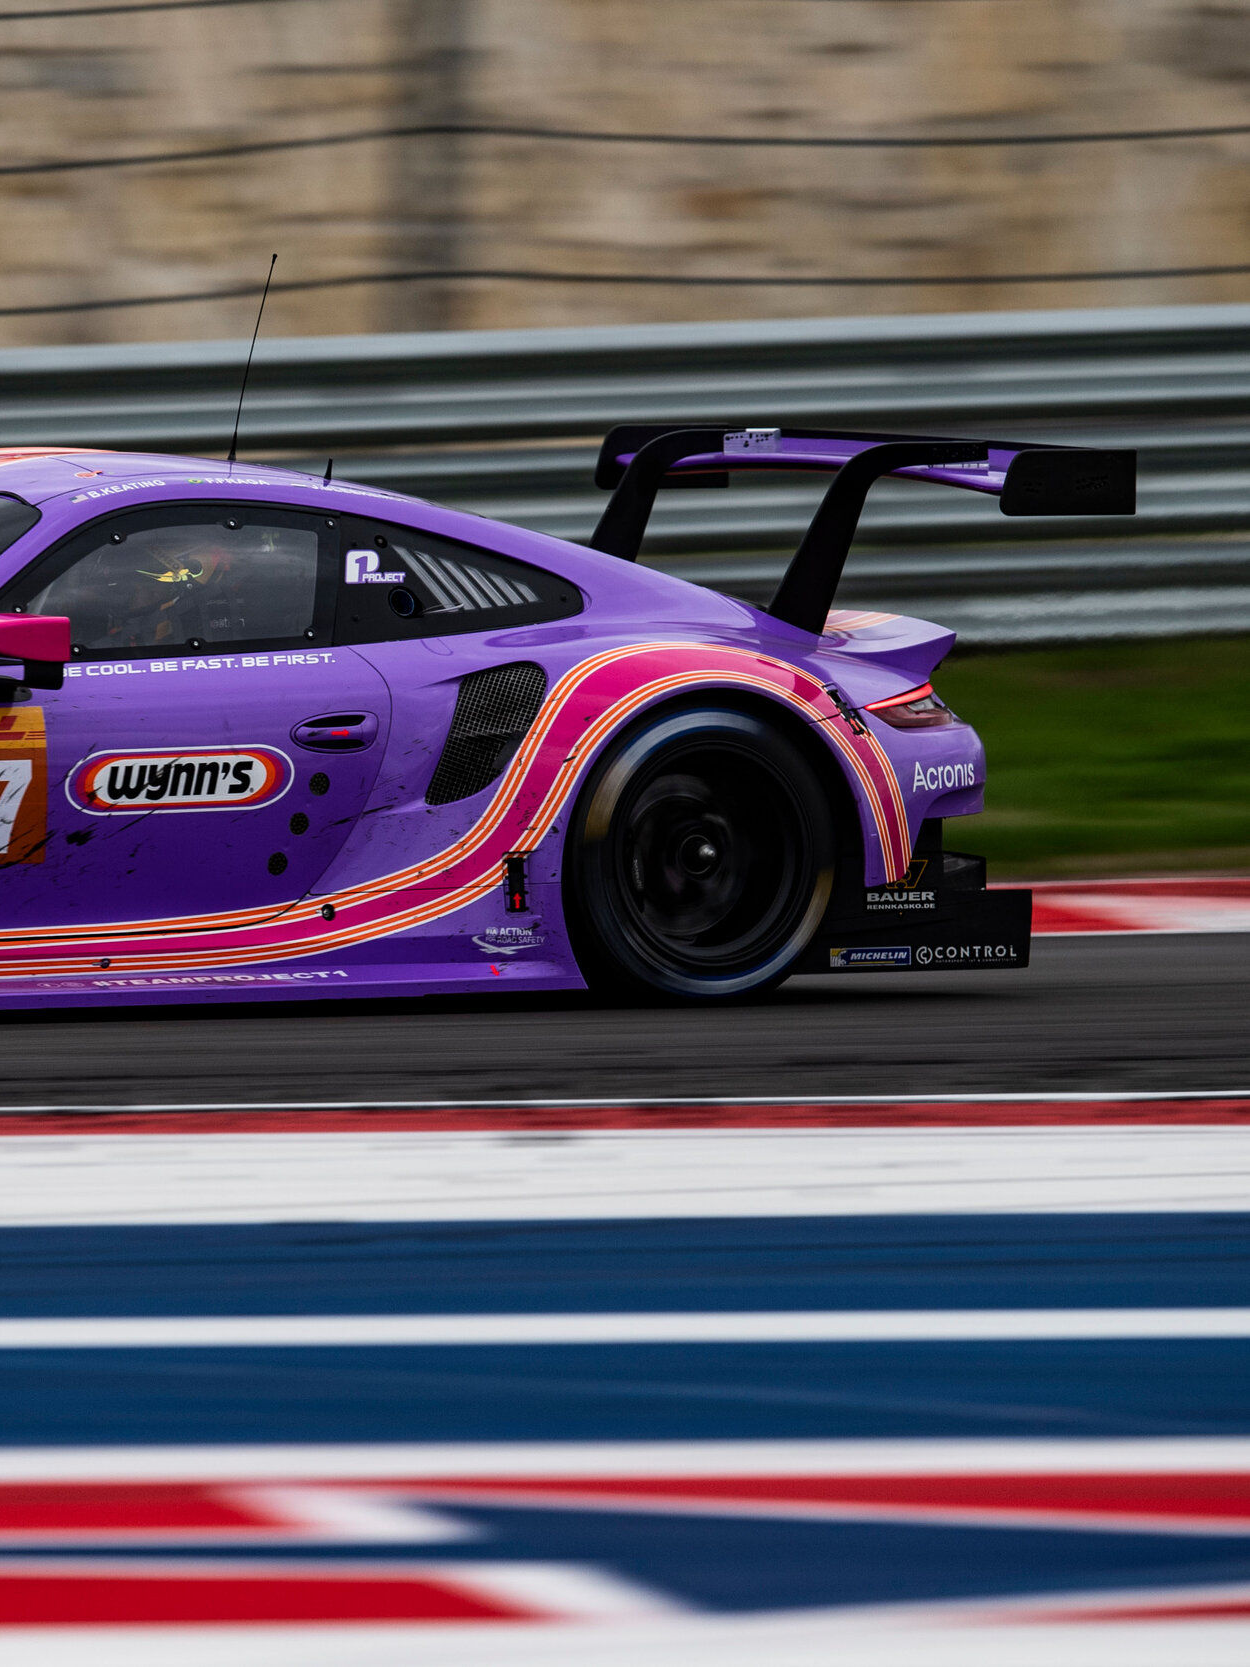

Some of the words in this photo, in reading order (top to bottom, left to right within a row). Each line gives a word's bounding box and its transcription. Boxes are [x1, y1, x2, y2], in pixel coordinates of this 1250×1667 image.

[87, 478, 166, 499] B.KEATING
[362, 573, 406, 582] PROJECT
[85, 663, 147, 676] COOL.
[149, 661, 179, 673] BE
[181, 658, 239, 671] FAST.
[241, 656, 270, 668] BE
[273, 652, 336, 666] FIRST.
[912, 761, 976, 793] Acronis
[866, 891, 936, 903] BAUER
[499, 927, 533, 936] ACTION
[518, 936, 546, 944] SAFETY
[850, 952, 908, 961] MICHELIN
[934, 945, 1018, 959] CONTROL
